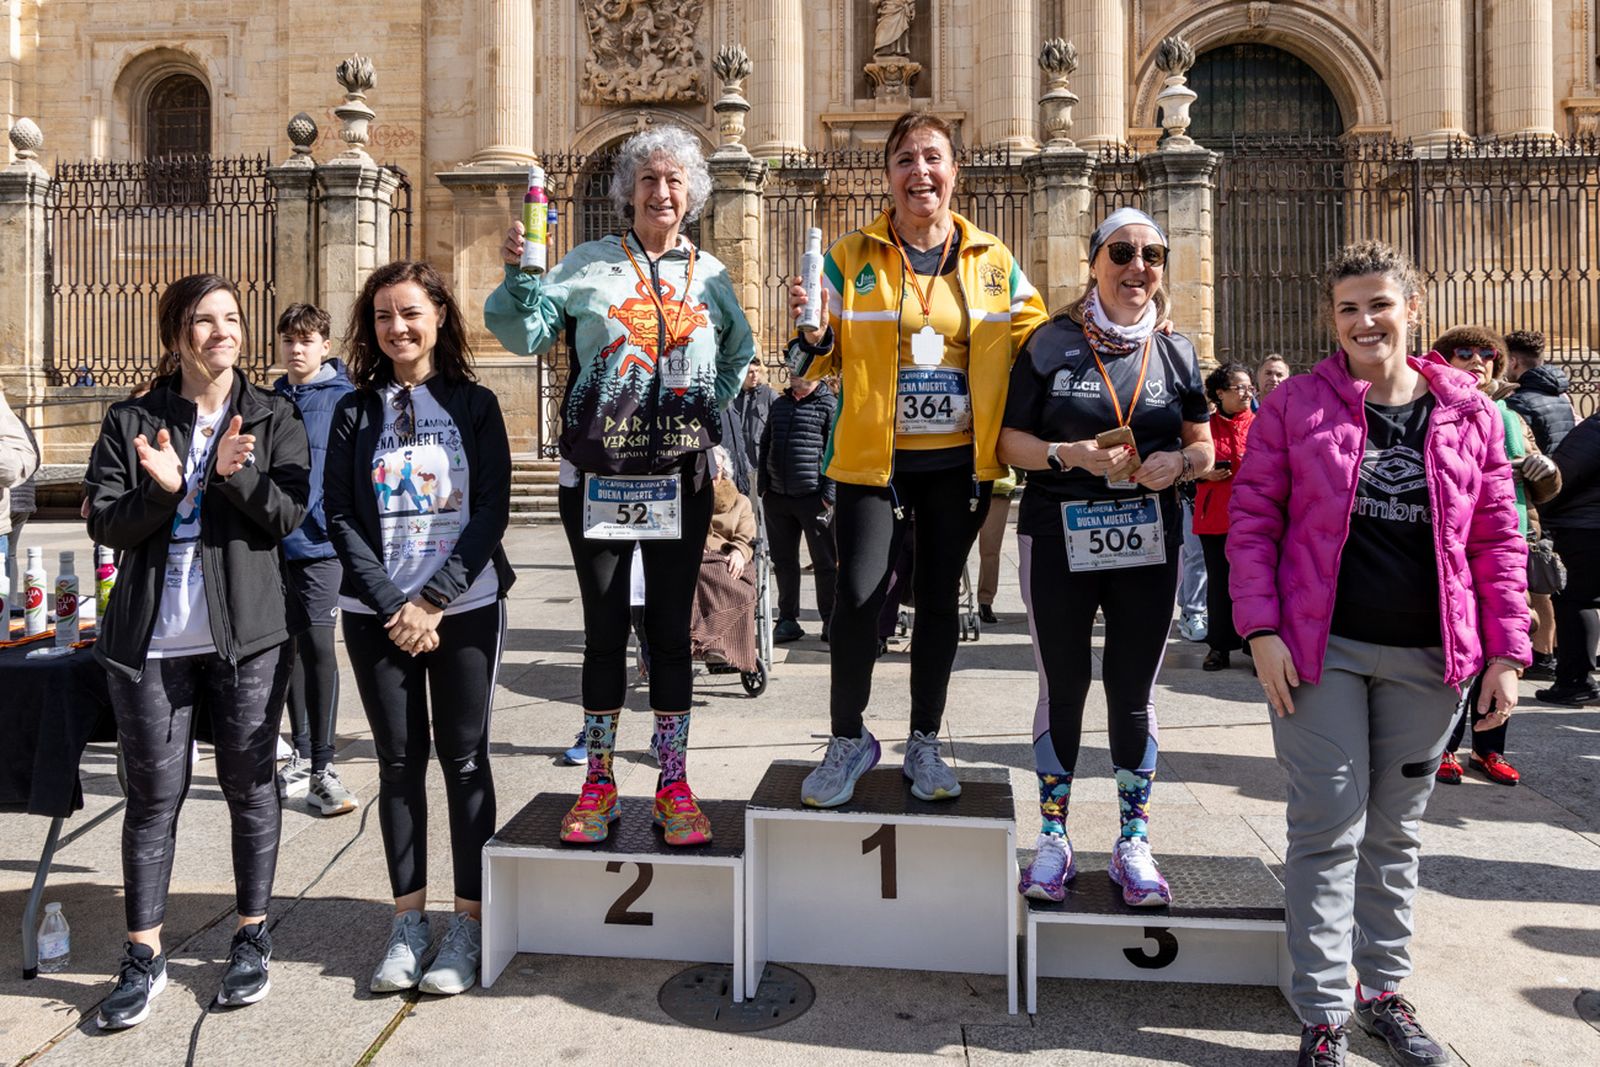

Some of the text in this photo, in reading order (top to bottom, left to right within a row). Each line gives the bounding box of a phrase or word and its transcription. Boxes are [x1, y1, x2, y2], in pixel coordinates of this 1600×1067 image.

[918, 382, 948, 392] MUERTE
[903, 395, 953, 419] 364
[398, 431, 445, 448] MUERTE
[602, 432, 700, 448] VIRGEN EXTRA
[623, 490, 653, 501] MUERTE
[615, 502, 648, 525] 52
[1077, 512, 1134, 527] BUENA MUERTE
[1089, 526, 1143, 554] 506
[862, 823, 897, 899] 1
[604, 860, 654, 926] 2
[1122, 926, 1179, 969] 3
